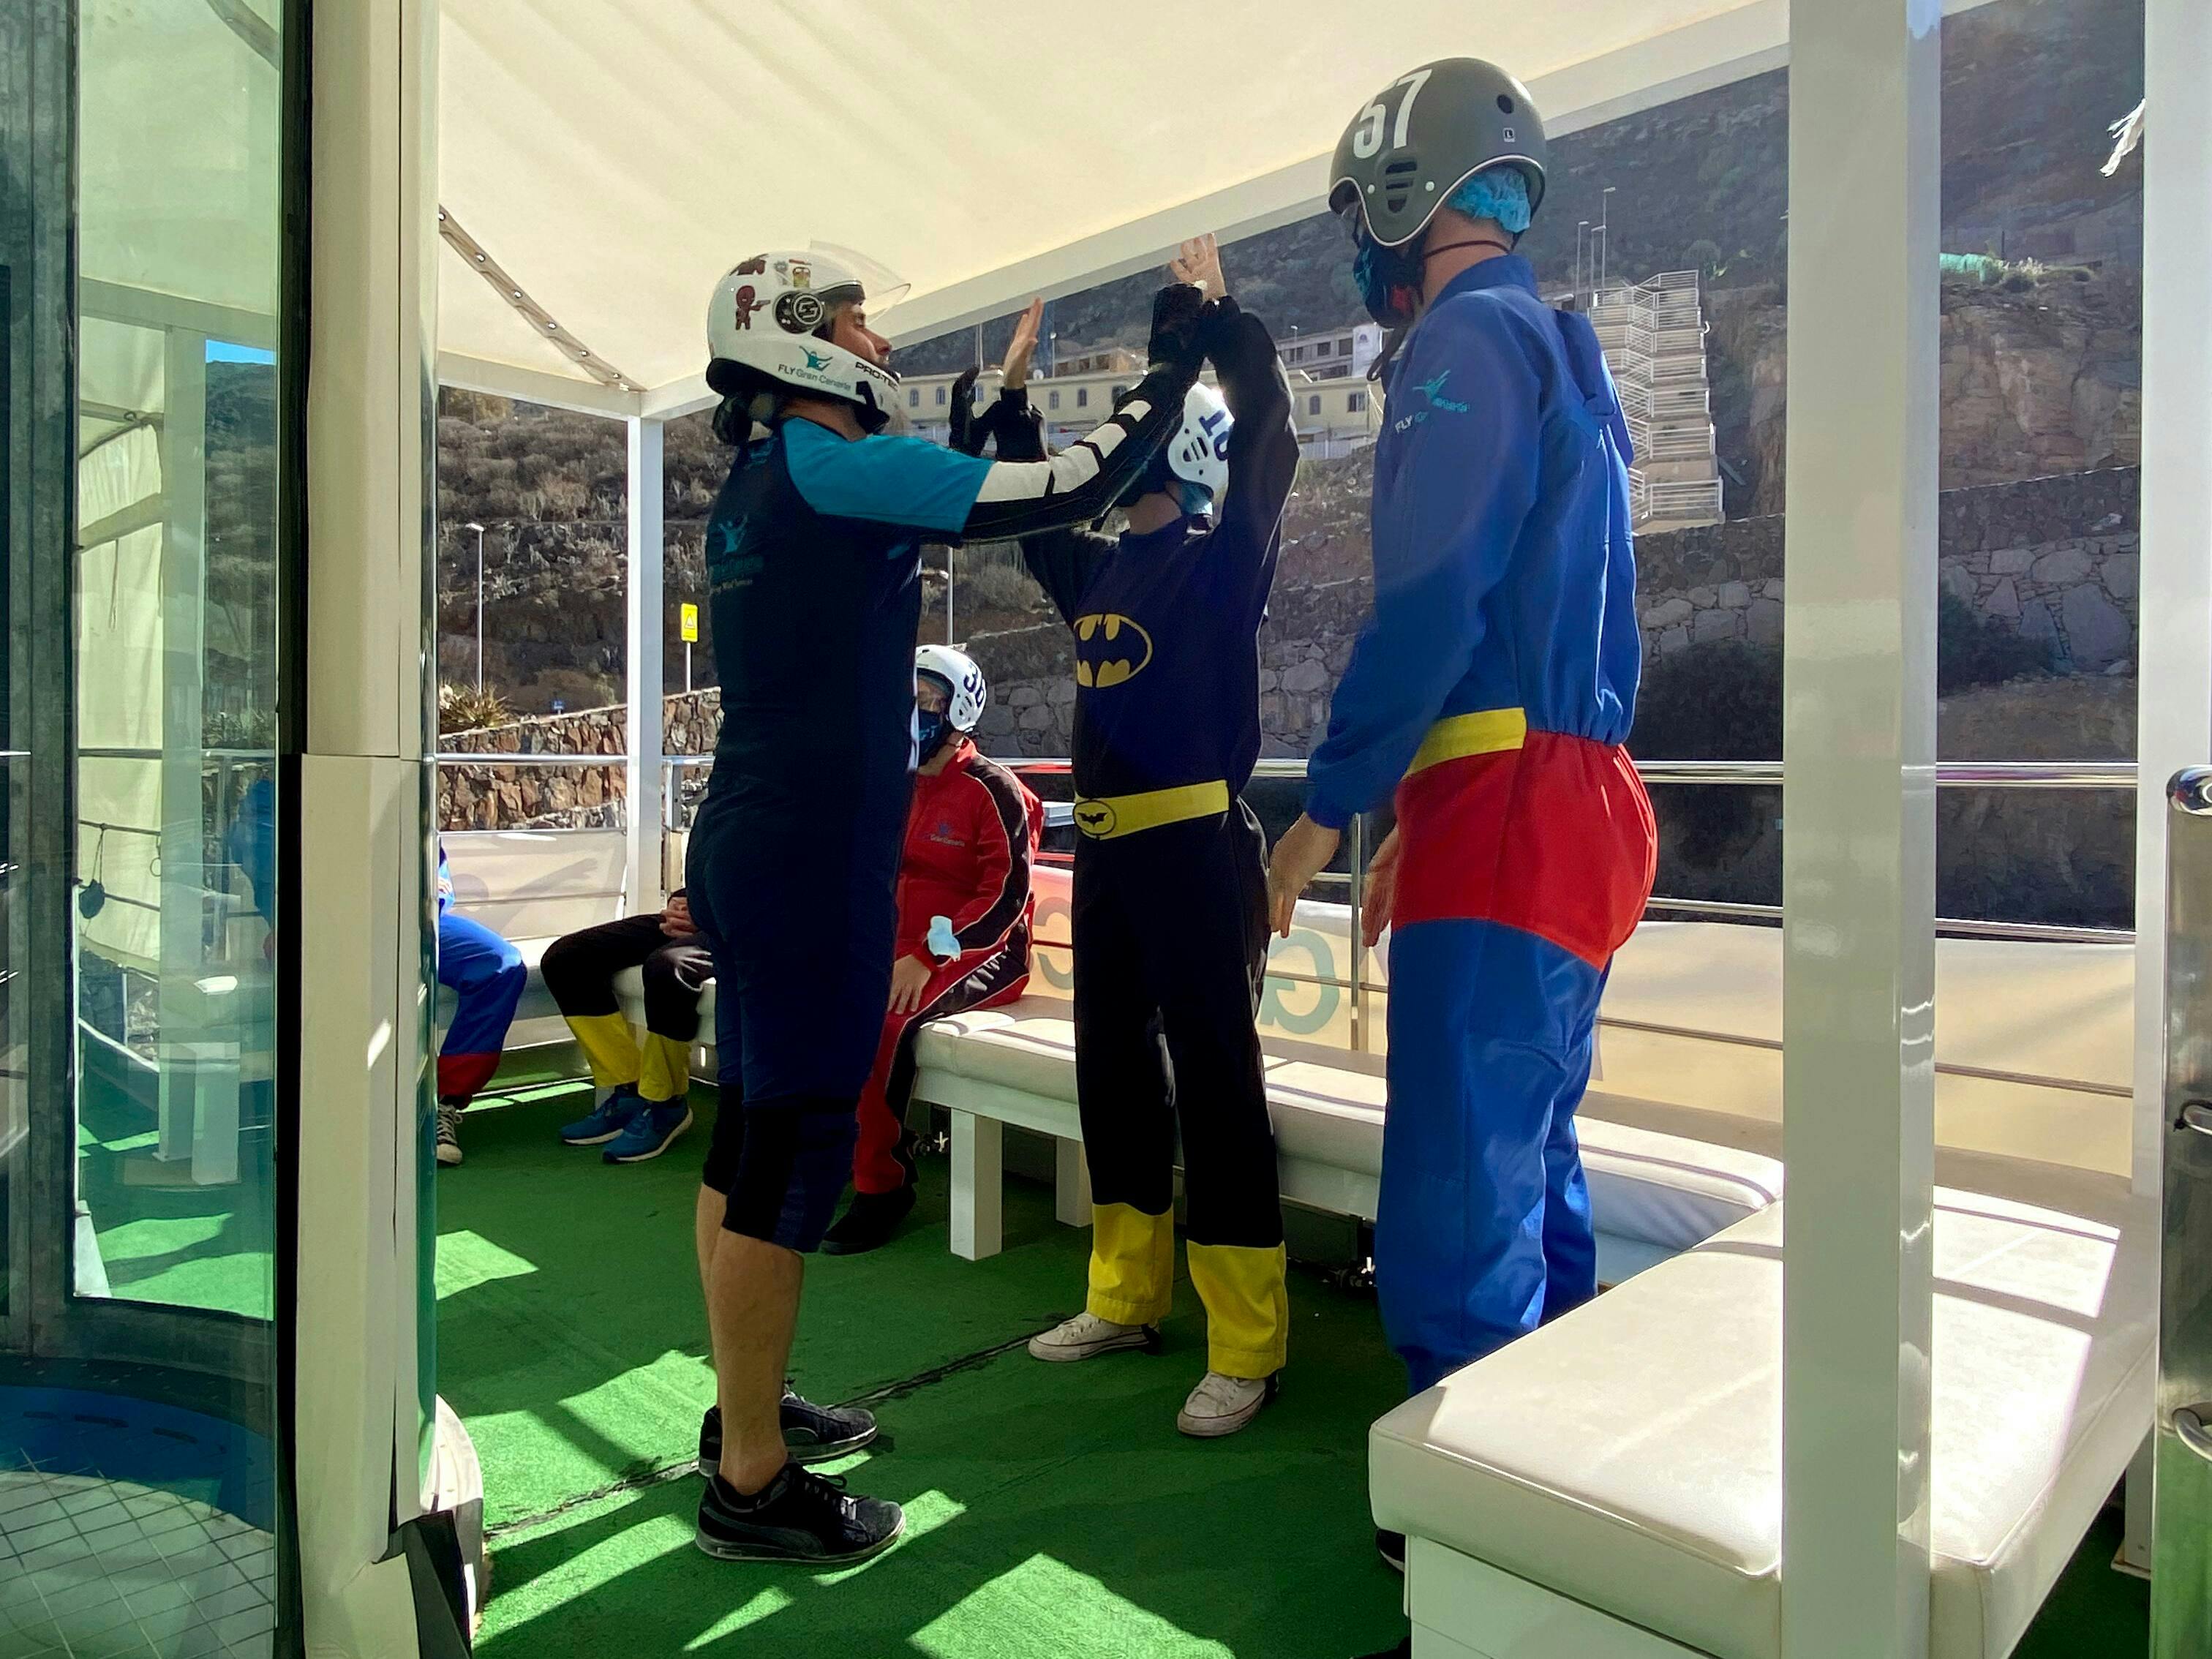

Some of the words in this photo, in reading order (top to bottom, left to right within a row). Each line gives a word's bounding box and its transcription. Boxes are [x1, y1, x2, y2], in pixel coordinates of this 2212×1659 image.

[1353, 69, 1432, 159] 57
[778, 364, 795, 376] FLY
[1395, 415, 1412, 434] FLY
